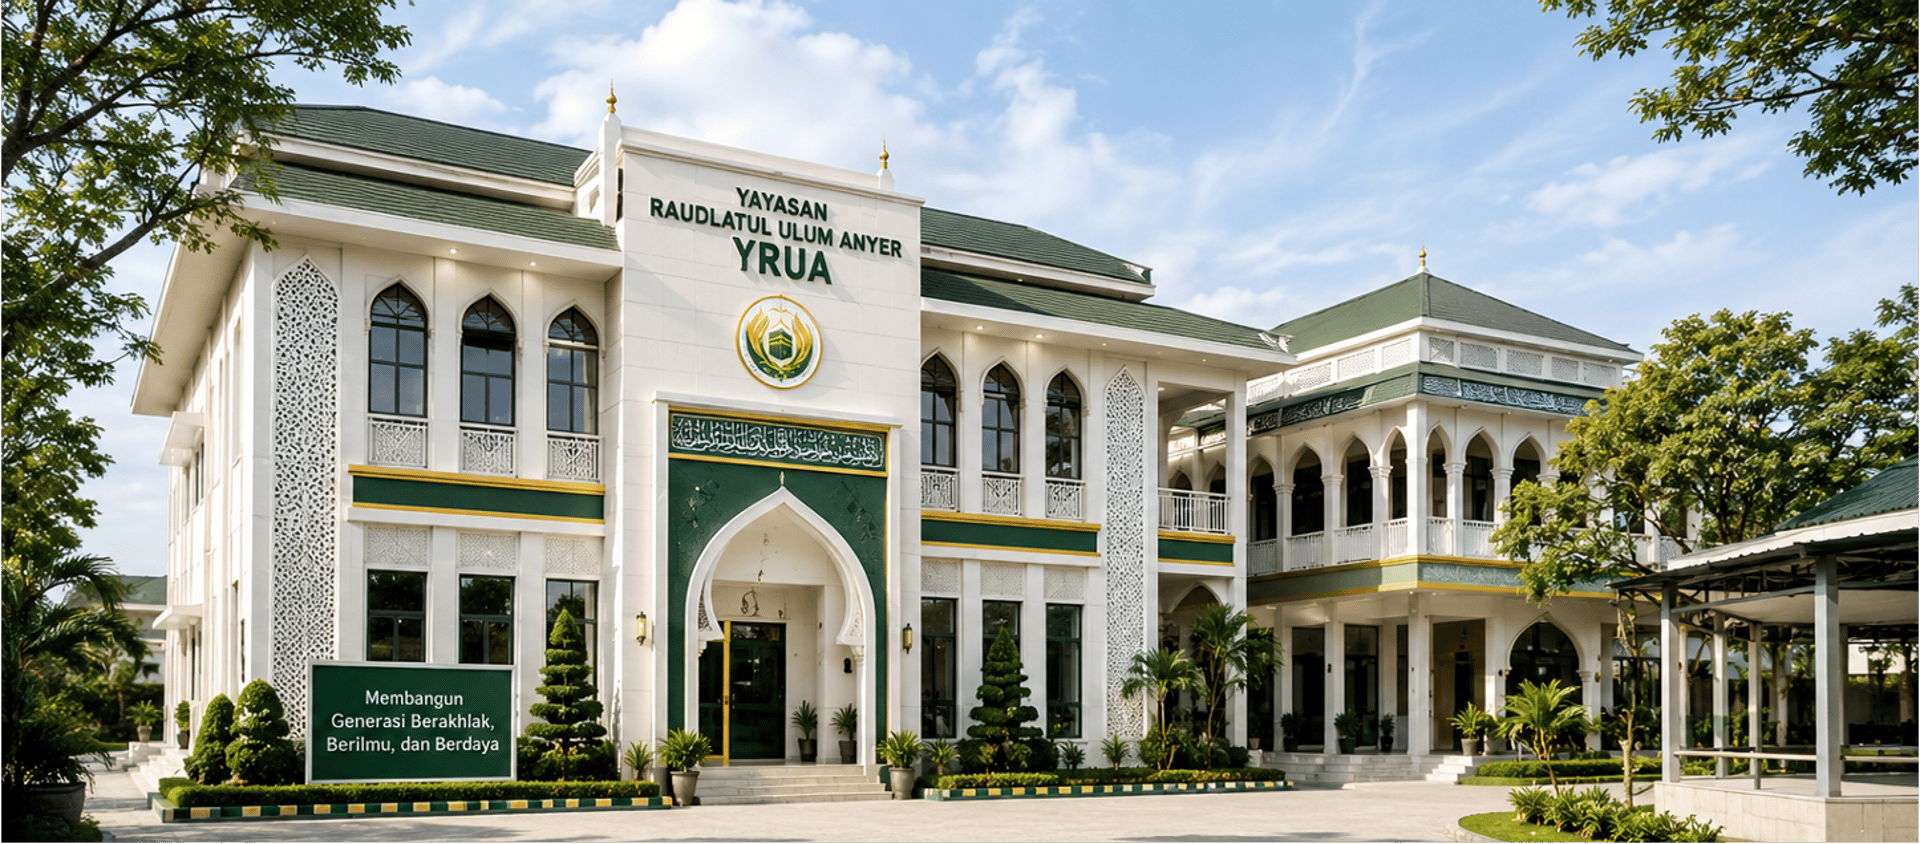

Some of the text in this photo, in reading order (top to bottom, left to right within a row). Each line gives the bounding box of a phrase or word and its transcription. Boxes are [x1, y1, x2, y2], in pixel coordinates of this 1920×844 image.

[736, 187, 828, 222] YAYASAN
[650, 197, 903, 258] RAUDLATUL ULUM ANYER
[732, 236, 832, 285] YRUA
[365, 690, 464, 709] Membangun
[331, 713, 495, 731] Generasi Berakhlak,
[327, 736, 500, 755] Berilmu, dan Berdaya
